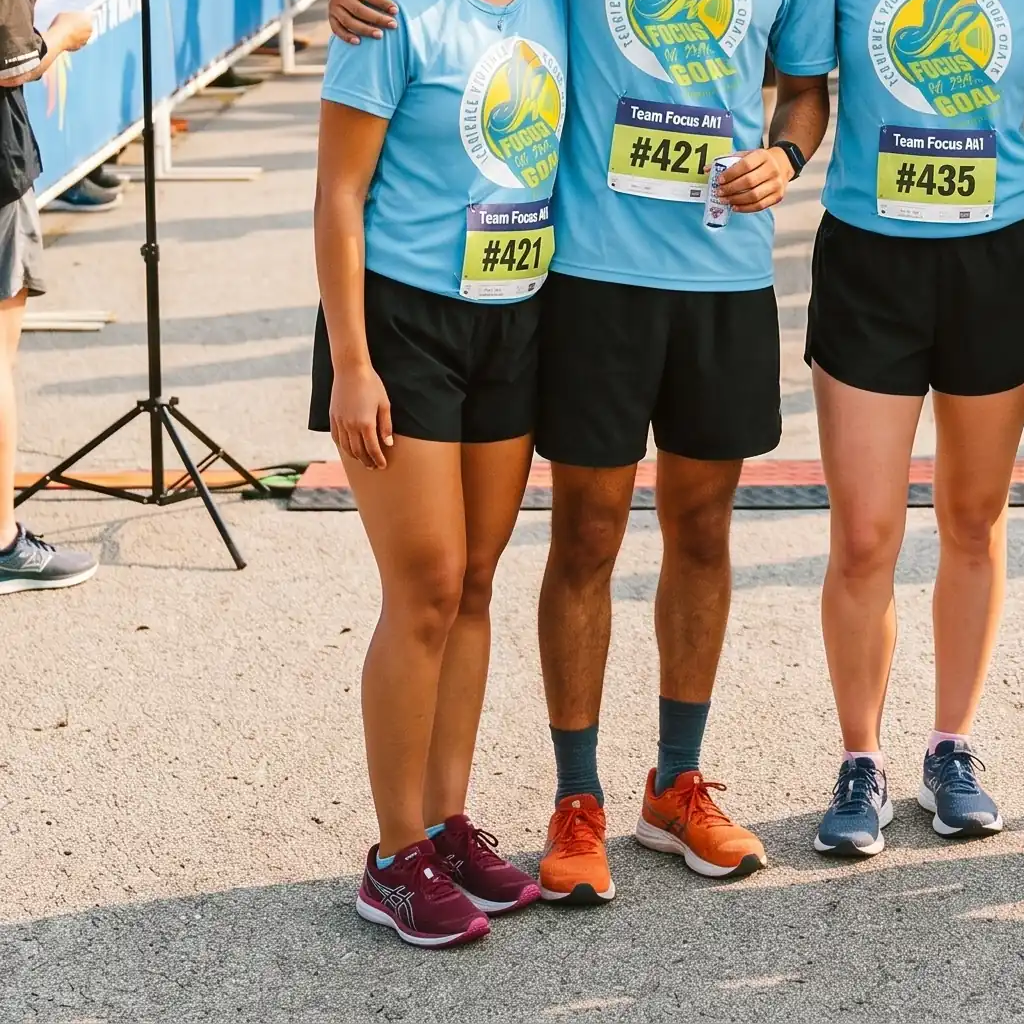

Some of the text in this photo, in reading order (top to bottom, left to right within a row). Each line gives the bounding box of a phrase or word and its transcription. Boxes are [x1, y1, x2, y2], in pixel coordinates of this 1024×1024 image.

[645, 22, 710, 48] FOCUS
[908, 54, 975, 82] FOCUS
[630, 106, 663, 124] Team
[665, 111, 699, 128] Focus
[630, 136, 709, 175] #421
[893, 133, 924, 149] Team
[927, 137, 963, 151] Focus
[896, 162, 976, 197] #435
[479, 210, 509, 224] Team
[482, 236, 542, 272] #421
